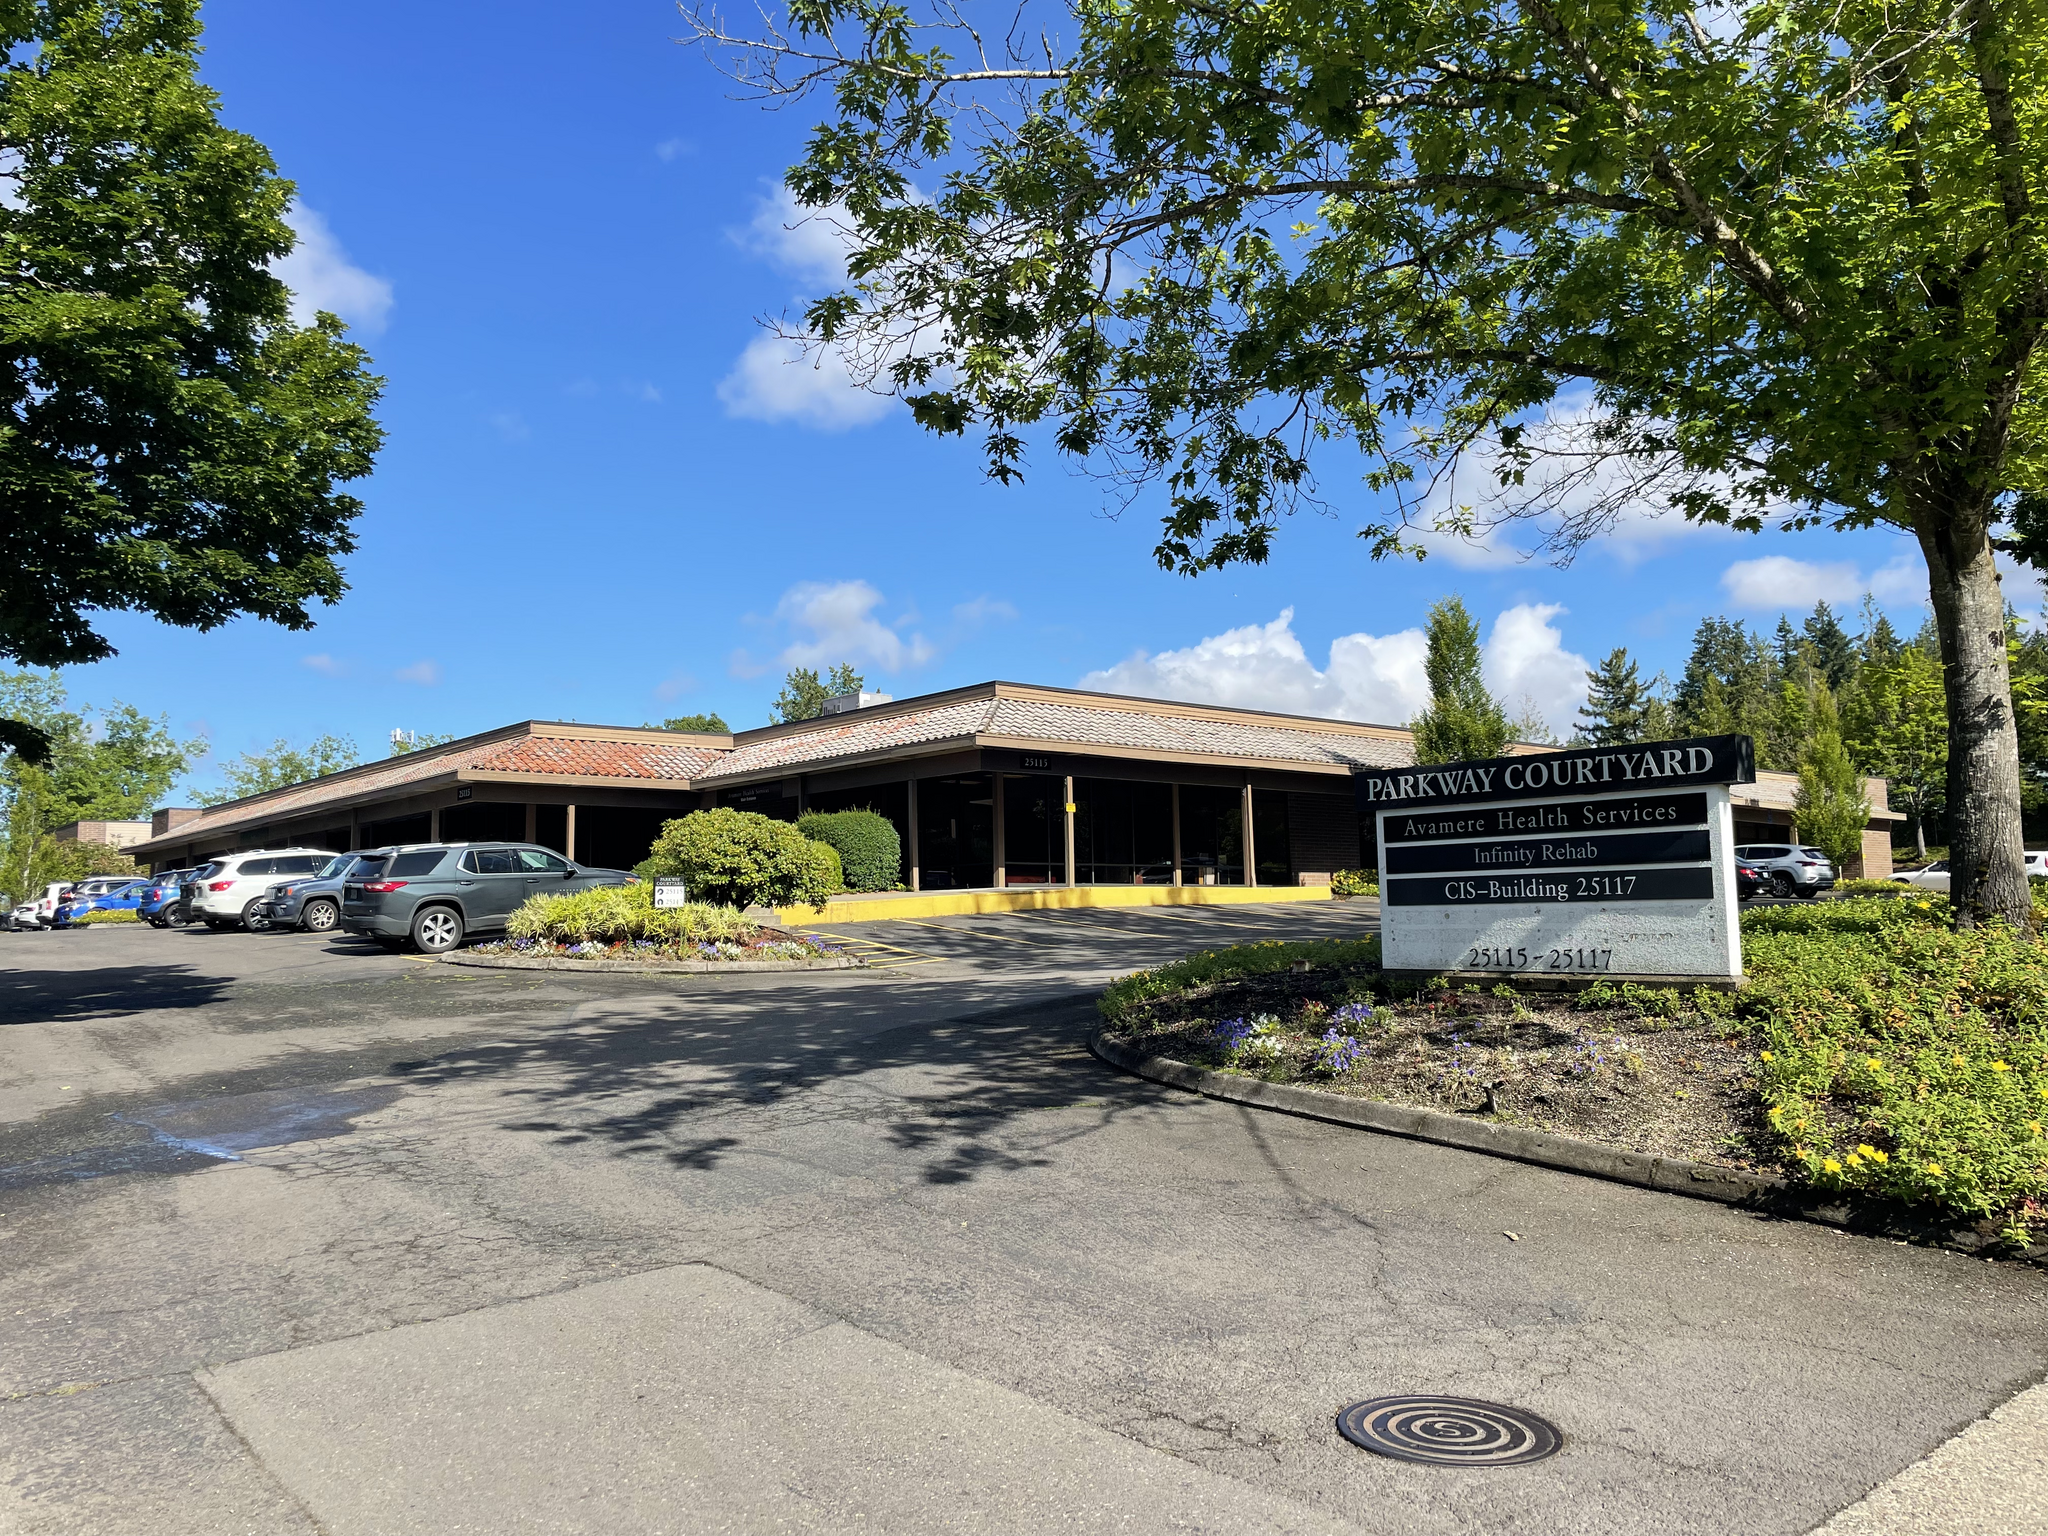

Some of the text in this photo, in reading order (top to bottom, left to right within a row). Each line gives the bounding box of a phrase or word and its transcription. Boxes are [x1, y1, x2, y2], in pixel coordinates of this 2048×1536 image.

[1024, 758, 1048, 768] 25115
[1366, 747, 1714, 802] PARKWAY COURTYARD
[1404, 801, 1678, 837] Avamere Health Services
[1473, 842, 1598, 867] Infinity Rehab
[1575, 876, 1637, 897] 25117
[1469, 948, 1528, 968] 25115
[1549, 949, 1613, 970] 25117
